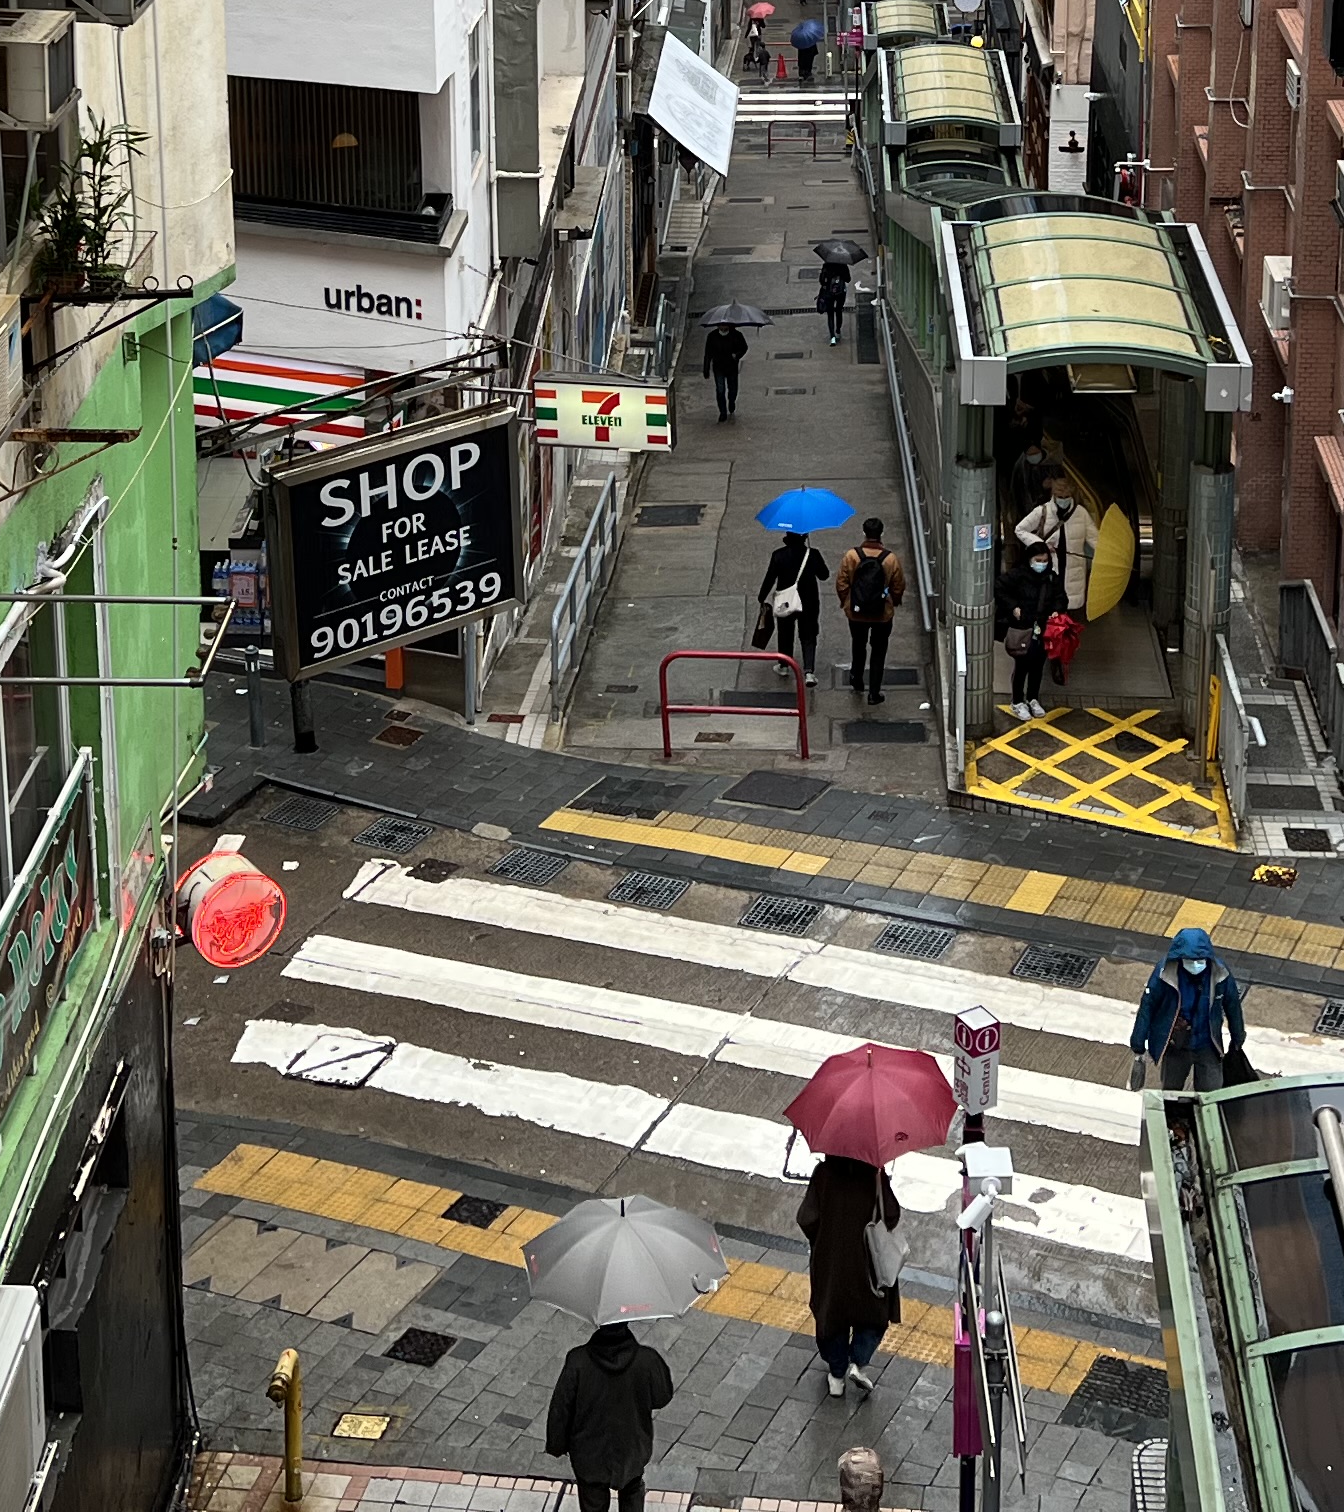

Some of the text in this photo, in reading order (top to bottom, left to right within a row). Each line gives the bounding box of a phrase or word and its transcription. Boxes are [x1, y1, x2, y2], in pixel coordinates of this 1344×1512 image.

[582, 390, 621, 442] 7
[320, 442, 480, 528] SHOP
[382, 513, 426, 543] FOR
[338, 526, 471, 585] SALE LEASE
[311, 572, 501, 658] 90196539
[379, 576, 434, 602] CONTACT
[979, 1057, 991, 1106] Central
